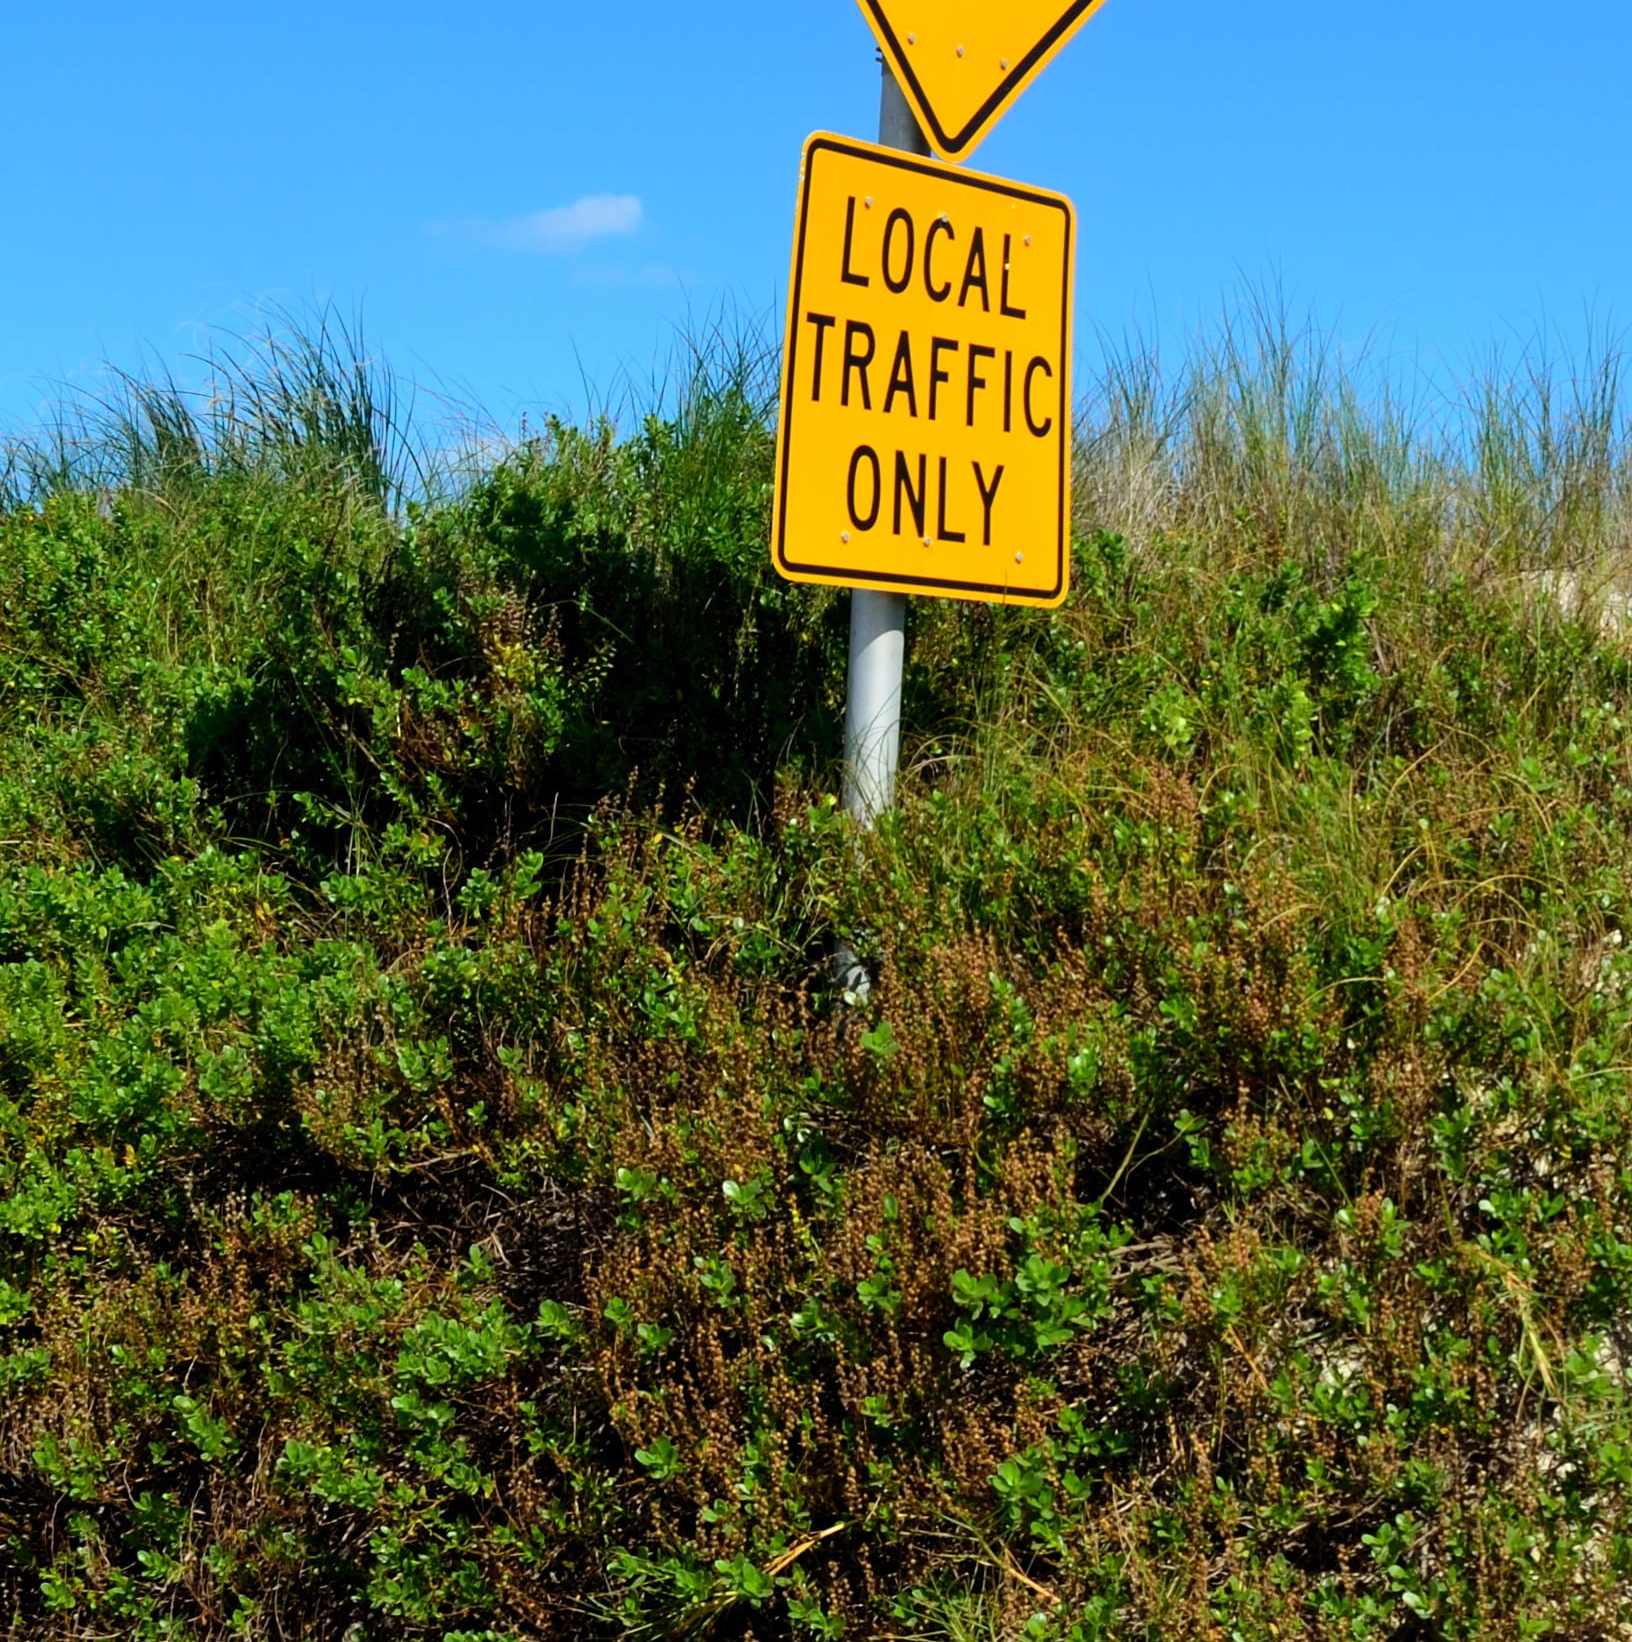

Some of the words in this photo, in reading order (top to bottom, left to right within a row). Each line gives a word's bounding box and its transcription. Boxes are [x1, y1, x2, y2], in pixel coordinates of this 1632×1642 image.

[840, 195, 1027, 319] LOCAL
[806, 311, 1053, 438] TRAFFIC
[846, 444, 1005, 546] ONLY
